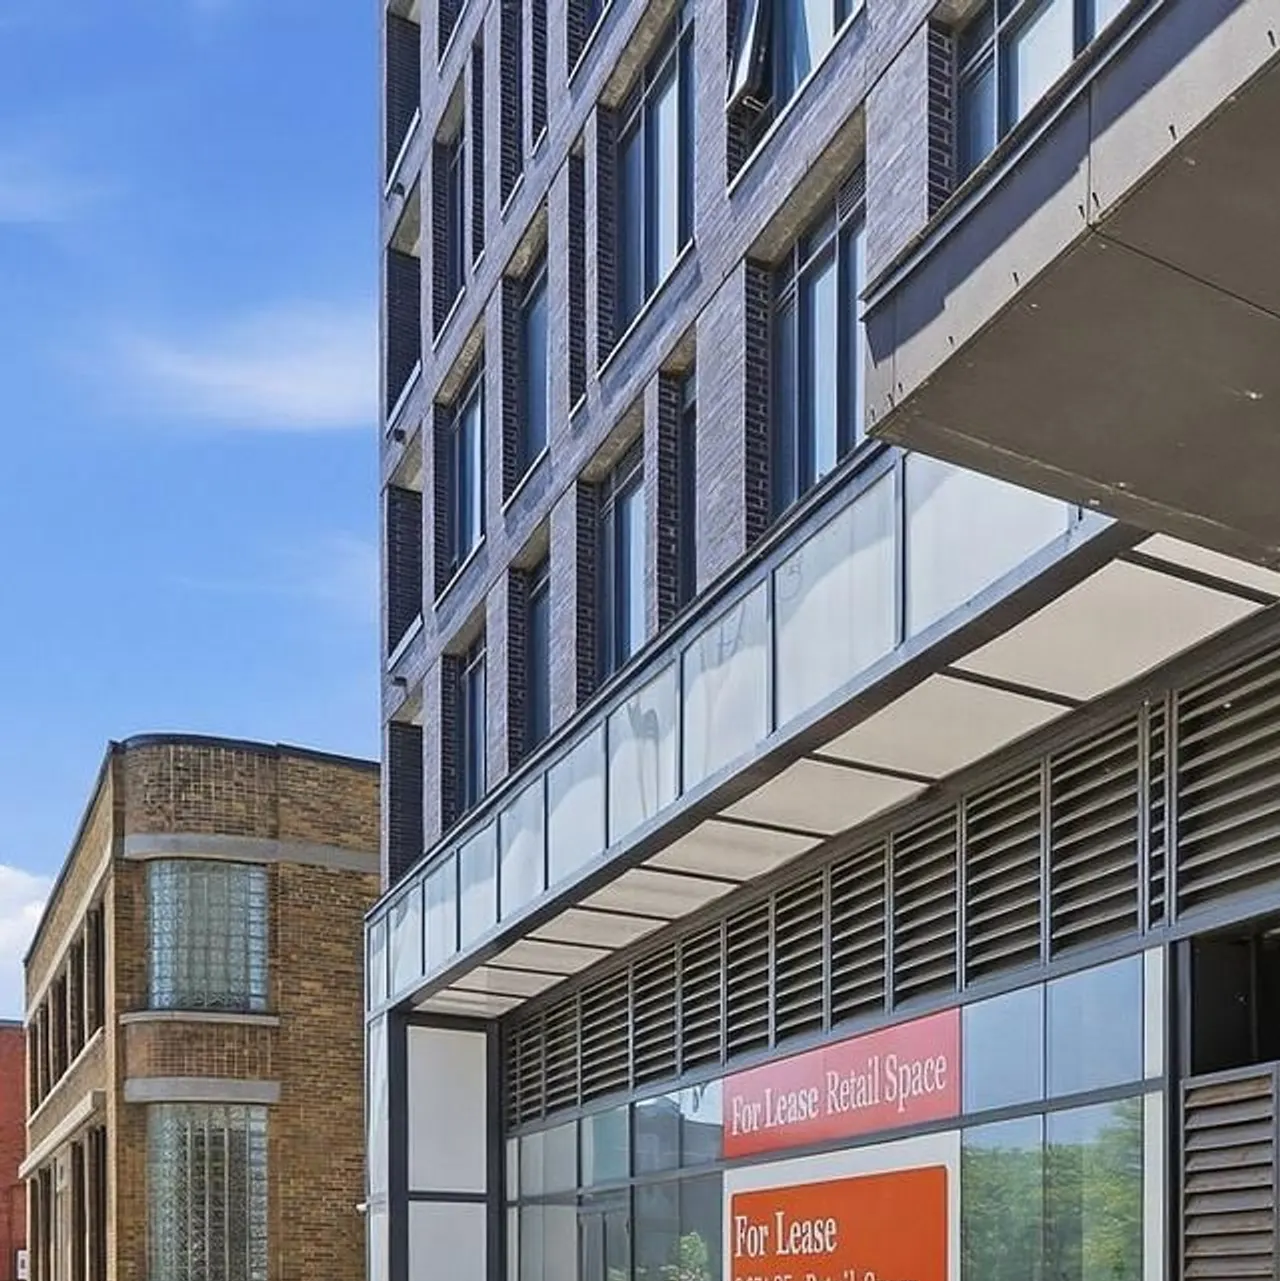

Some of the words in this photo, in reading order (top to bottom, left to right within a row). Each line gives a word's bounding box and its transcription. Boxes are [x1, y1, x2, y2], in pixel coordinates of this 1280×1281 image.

[731, 1096, 762, 1136] For
[764, 1087, 820, 1129] Lease
[826, 1055, 880, 1115] Retail
[885, 1053, 948, 1113] Space
[734, 1215, 769, 1258] For
[775, 1211, 838, 1256] Lease
